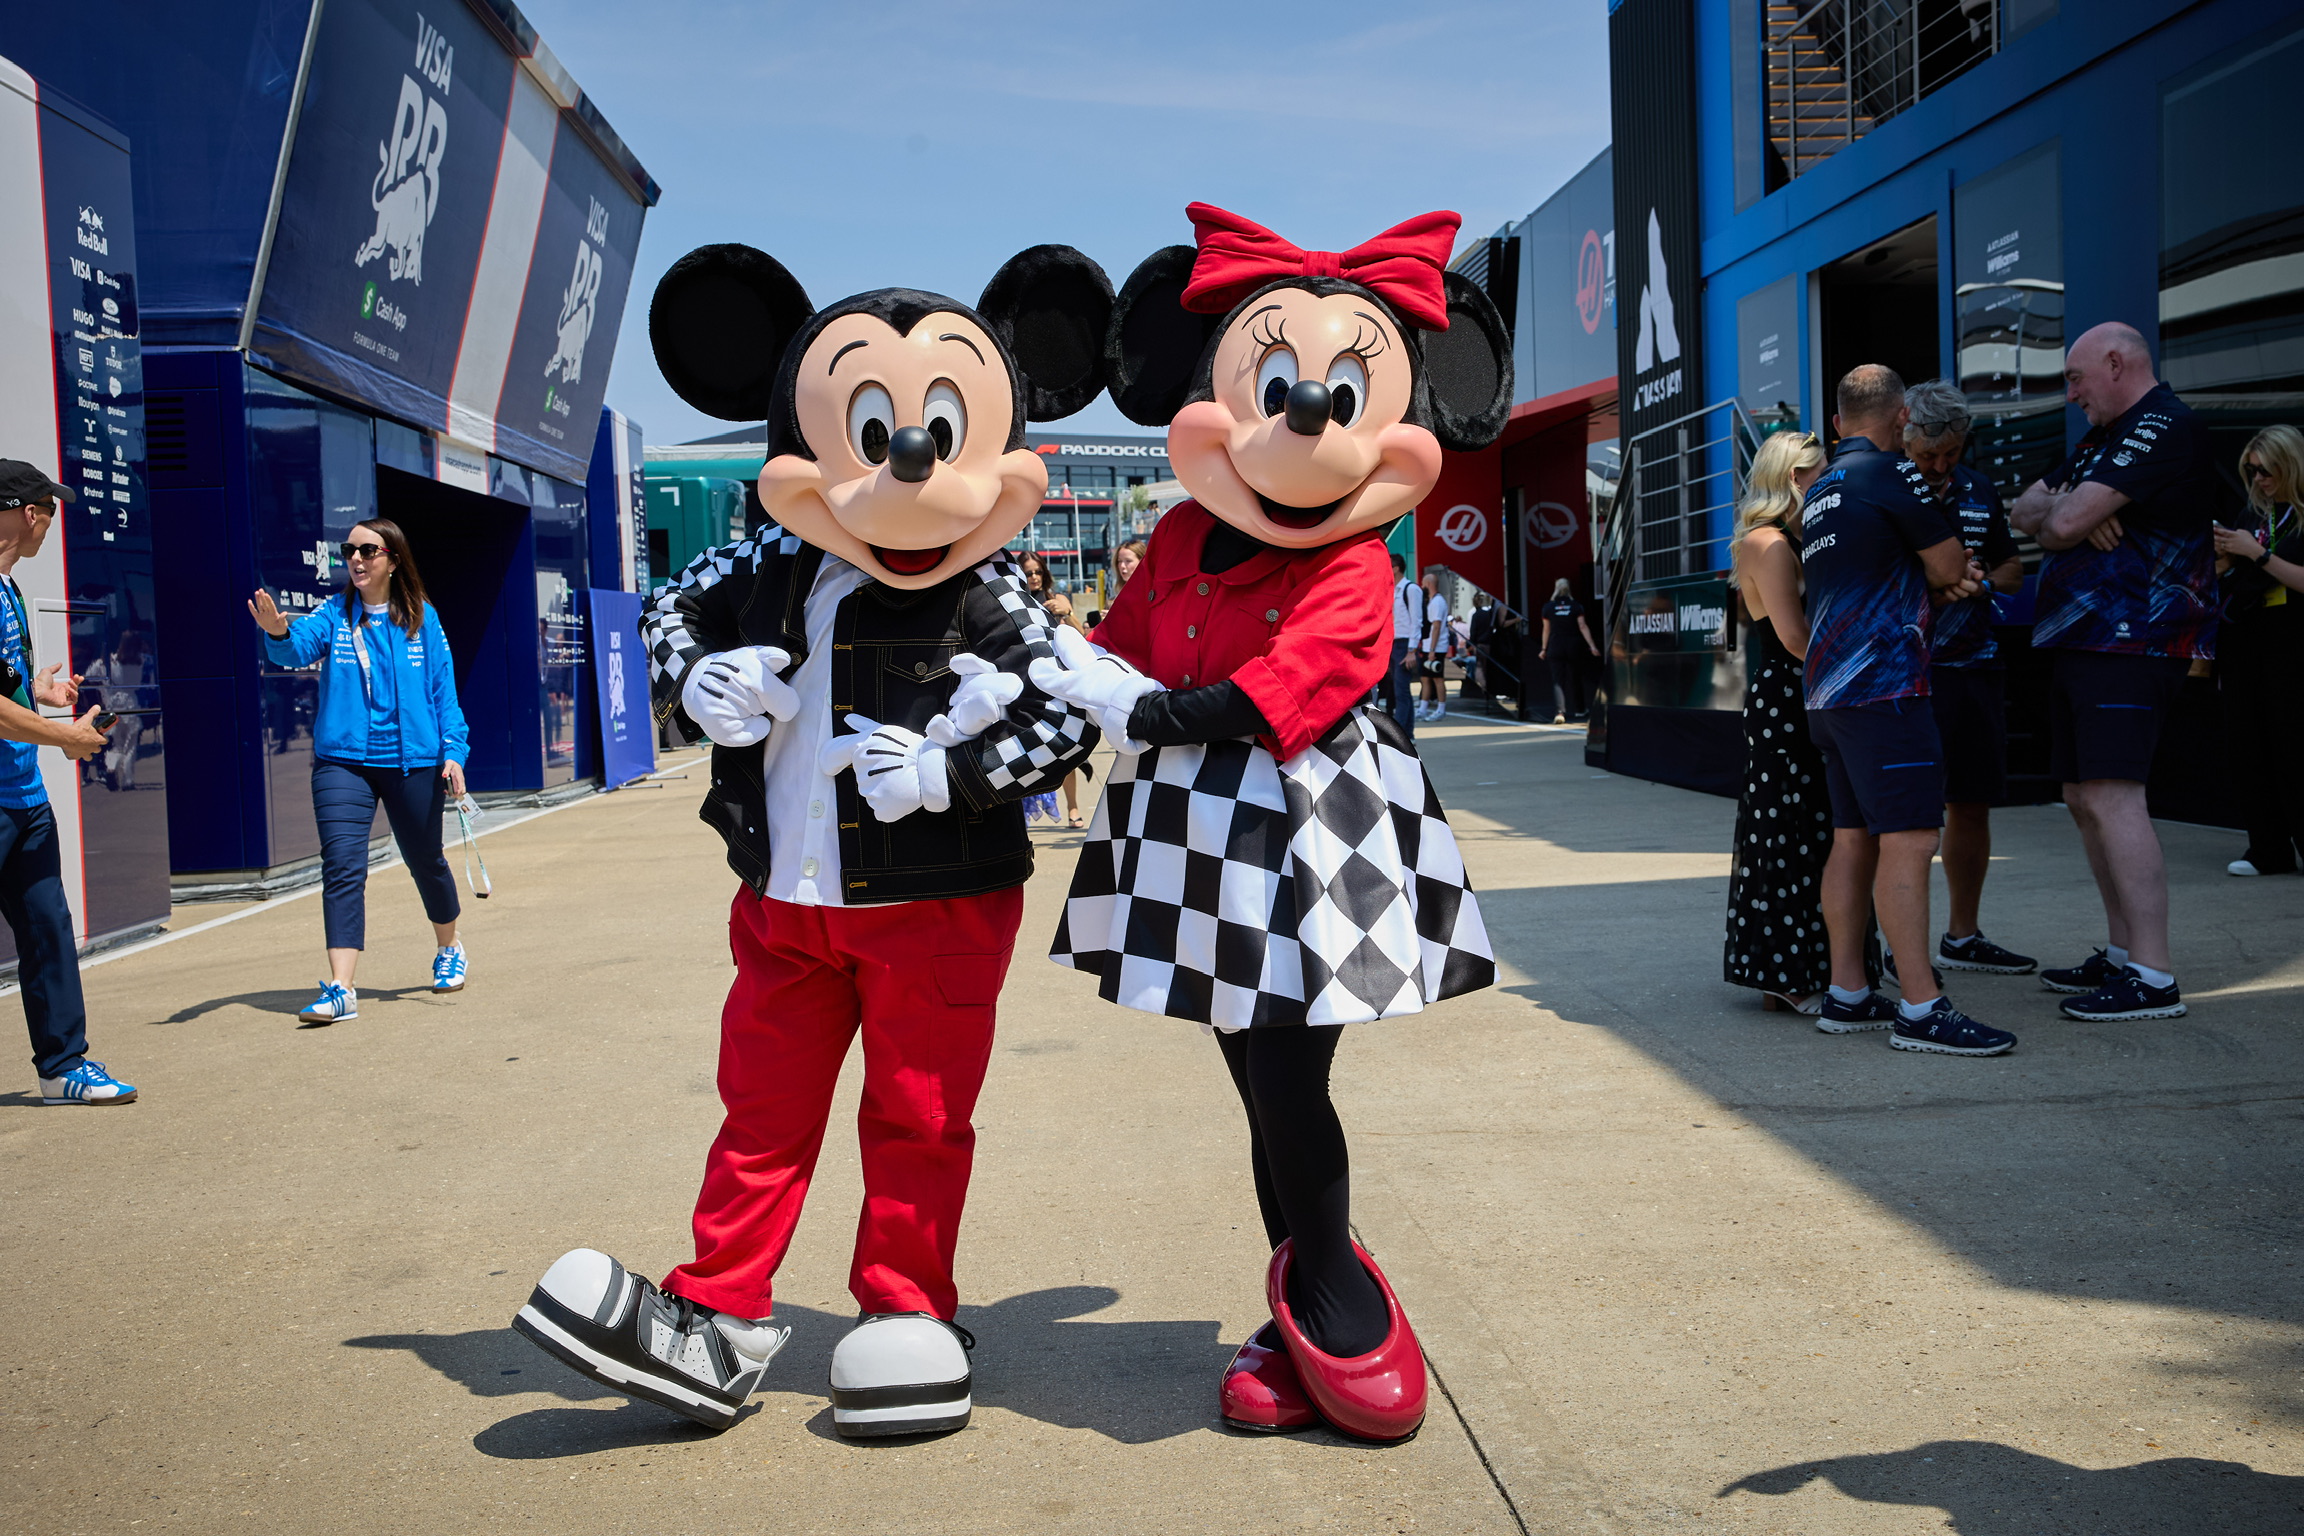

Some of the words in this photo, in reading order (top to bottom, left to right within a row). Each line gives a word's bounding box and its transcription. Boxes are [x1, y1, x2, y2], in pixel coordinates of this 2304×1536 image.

[415, 11, 454, 96] VISA
[587, 194, 609, 248] VISA
[77, 226, 93, 249] Red
[93, 233, 108, 256] Bull
[69, 256, 92, 282] VISA
[73, 308, 95, 327] HUGO
[376, 296, 394, 322] Cash
[392, 306, 407, 333] App
[353, 331, 376, 351] FORMULA
[376, 342, 388, 357] ONE
[387, 347, 400, 362] TEAM
[105, 356, 122, 370] TUDOR
[82, 449, 102, 462] SIEMENS
[1061, 444, 1148, 457] PADDOCK
[1149, 446, 1169, 458] CL
[2122, 438, 2152, 453] PIRELLI
[6, 498, 21, 507] Y-3
[1805, 533, 1836, 560] BARCLAYS
[1680, 604, 1724, 632] Williams
